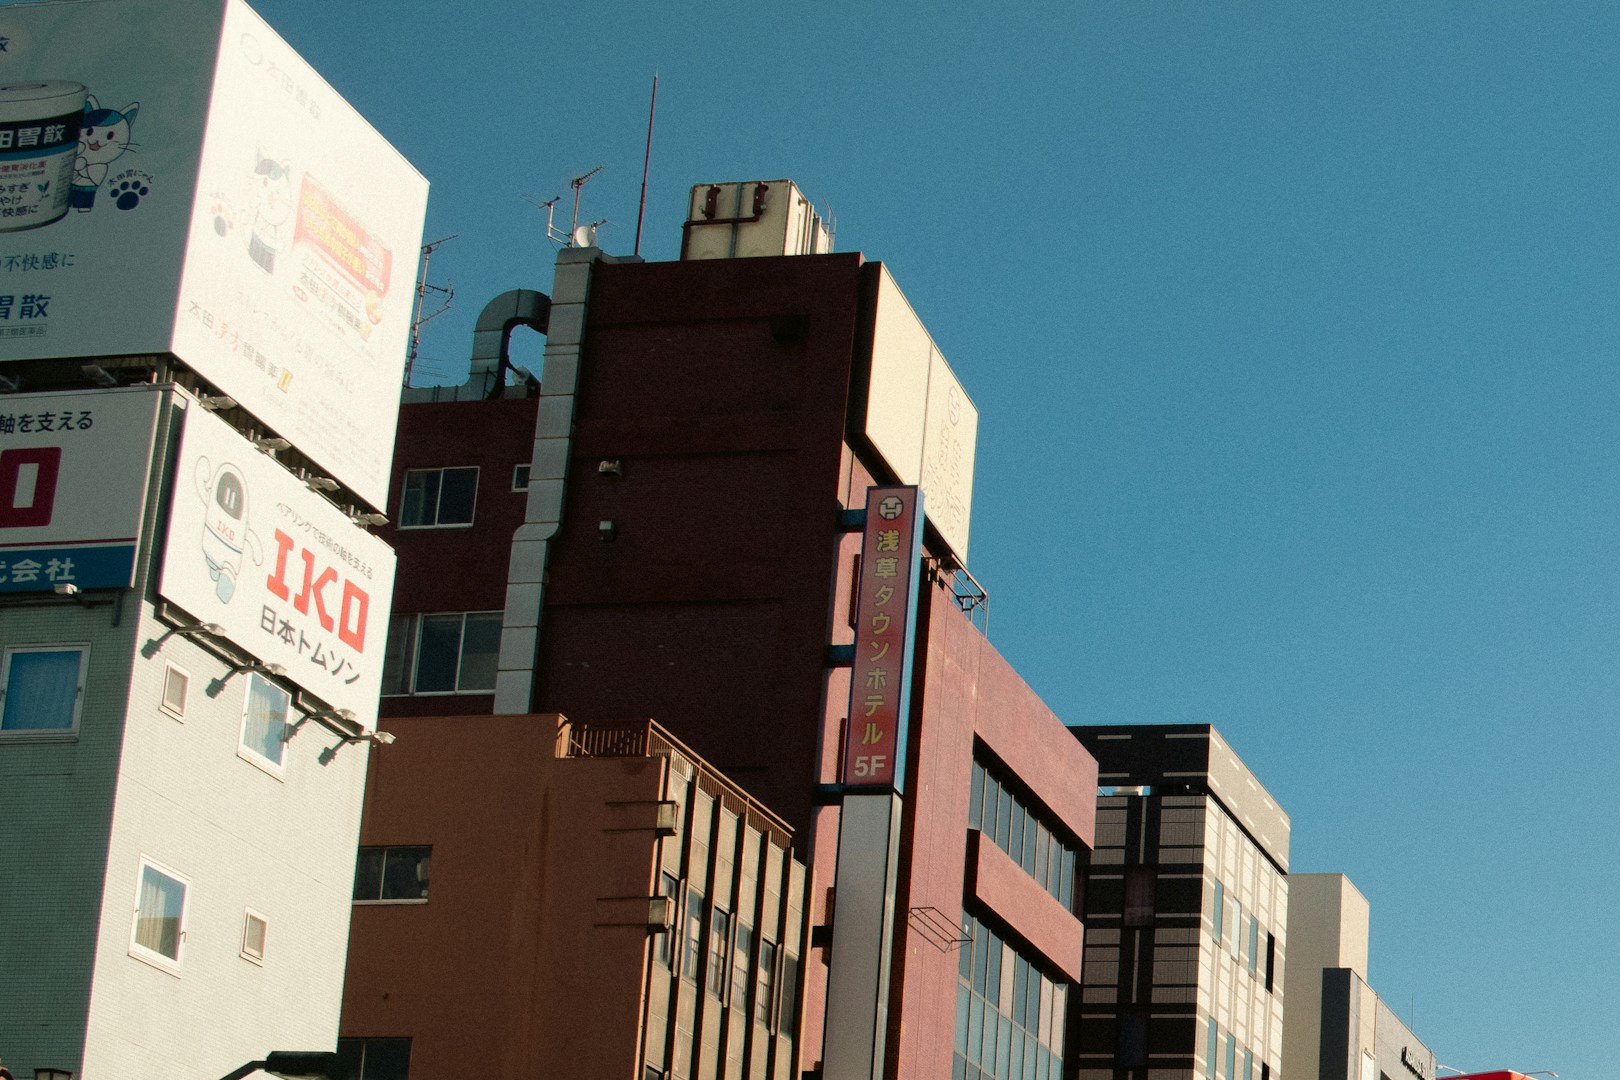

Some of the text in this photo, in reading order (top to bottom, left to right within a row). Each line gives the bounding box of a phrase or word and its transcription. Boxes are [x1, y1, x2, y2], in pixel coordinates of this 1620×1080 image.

[0, 252, 75, 273] 不快感に
[217, 520, 235, 541] IKO
[266, 527, 370, 654] IKO
[260, 604, 360, 684] 日本トムソン
[861, 529, 901, 746] 浅草タウンホテル
[854, 755, 887, 777] 5F
